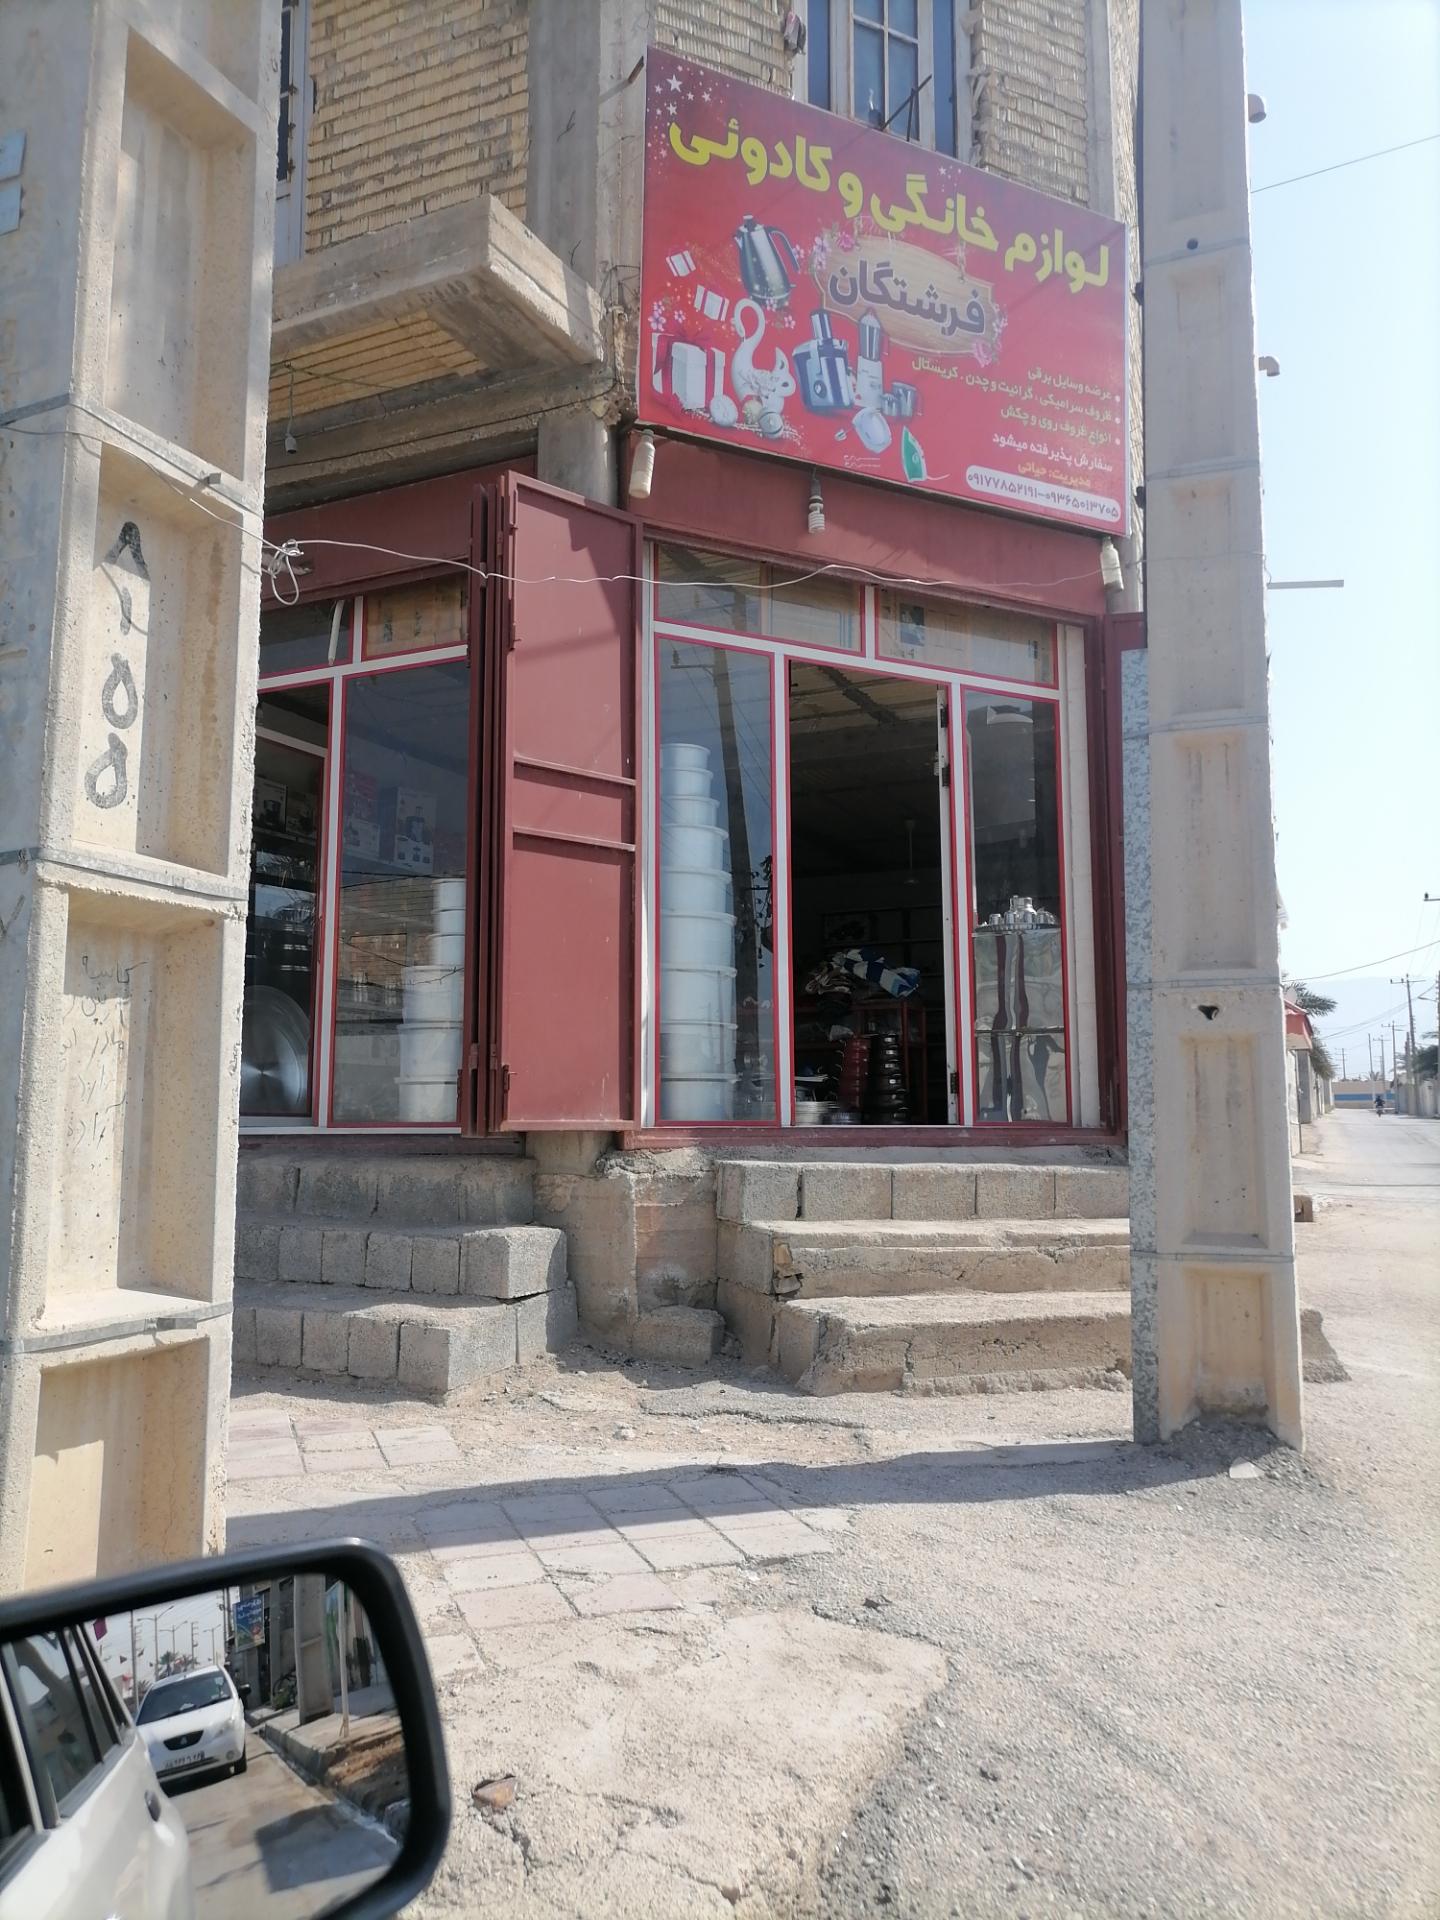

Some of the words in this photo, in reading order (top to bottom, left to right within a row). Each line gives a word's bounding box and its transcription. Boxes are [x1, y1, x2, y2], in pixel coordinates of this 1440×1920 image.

[669, 118, 832, 192] کادوئی
[838, 172, 863, 218] و
[870, 174, 999, 251] خانگی
[1004, 228, 1109, 293] لوازم
[829, 259, 985, 336] فرشتگان
[912, 357, 959, 379] کریستال
[1027, 367, 1052, 385] برقی
[990, 380, 997, 392] و
[998, 381, 1033, 400] گرانیت
[1053, 374, 1084, 394] وسایل
[1085, 384, 1112, 400] عرضه
[1000, 405, 1029, 426] چکش
[1031, 414, 1037, 426] و
[1084, 405, 1112, 422] ظروف
[1040, 417, 1058, 432] روی
[1060, 421, 1087, 438] ظروف
[993, 433, 1028, 451] میشود
[1088, 430, 1112, 445] انواع
[1030, 442, 1072, 467] پذیرفته
[1074, 453, 1113, 472] سفارش
[1017, 461, 1048, 477] حیاتی
